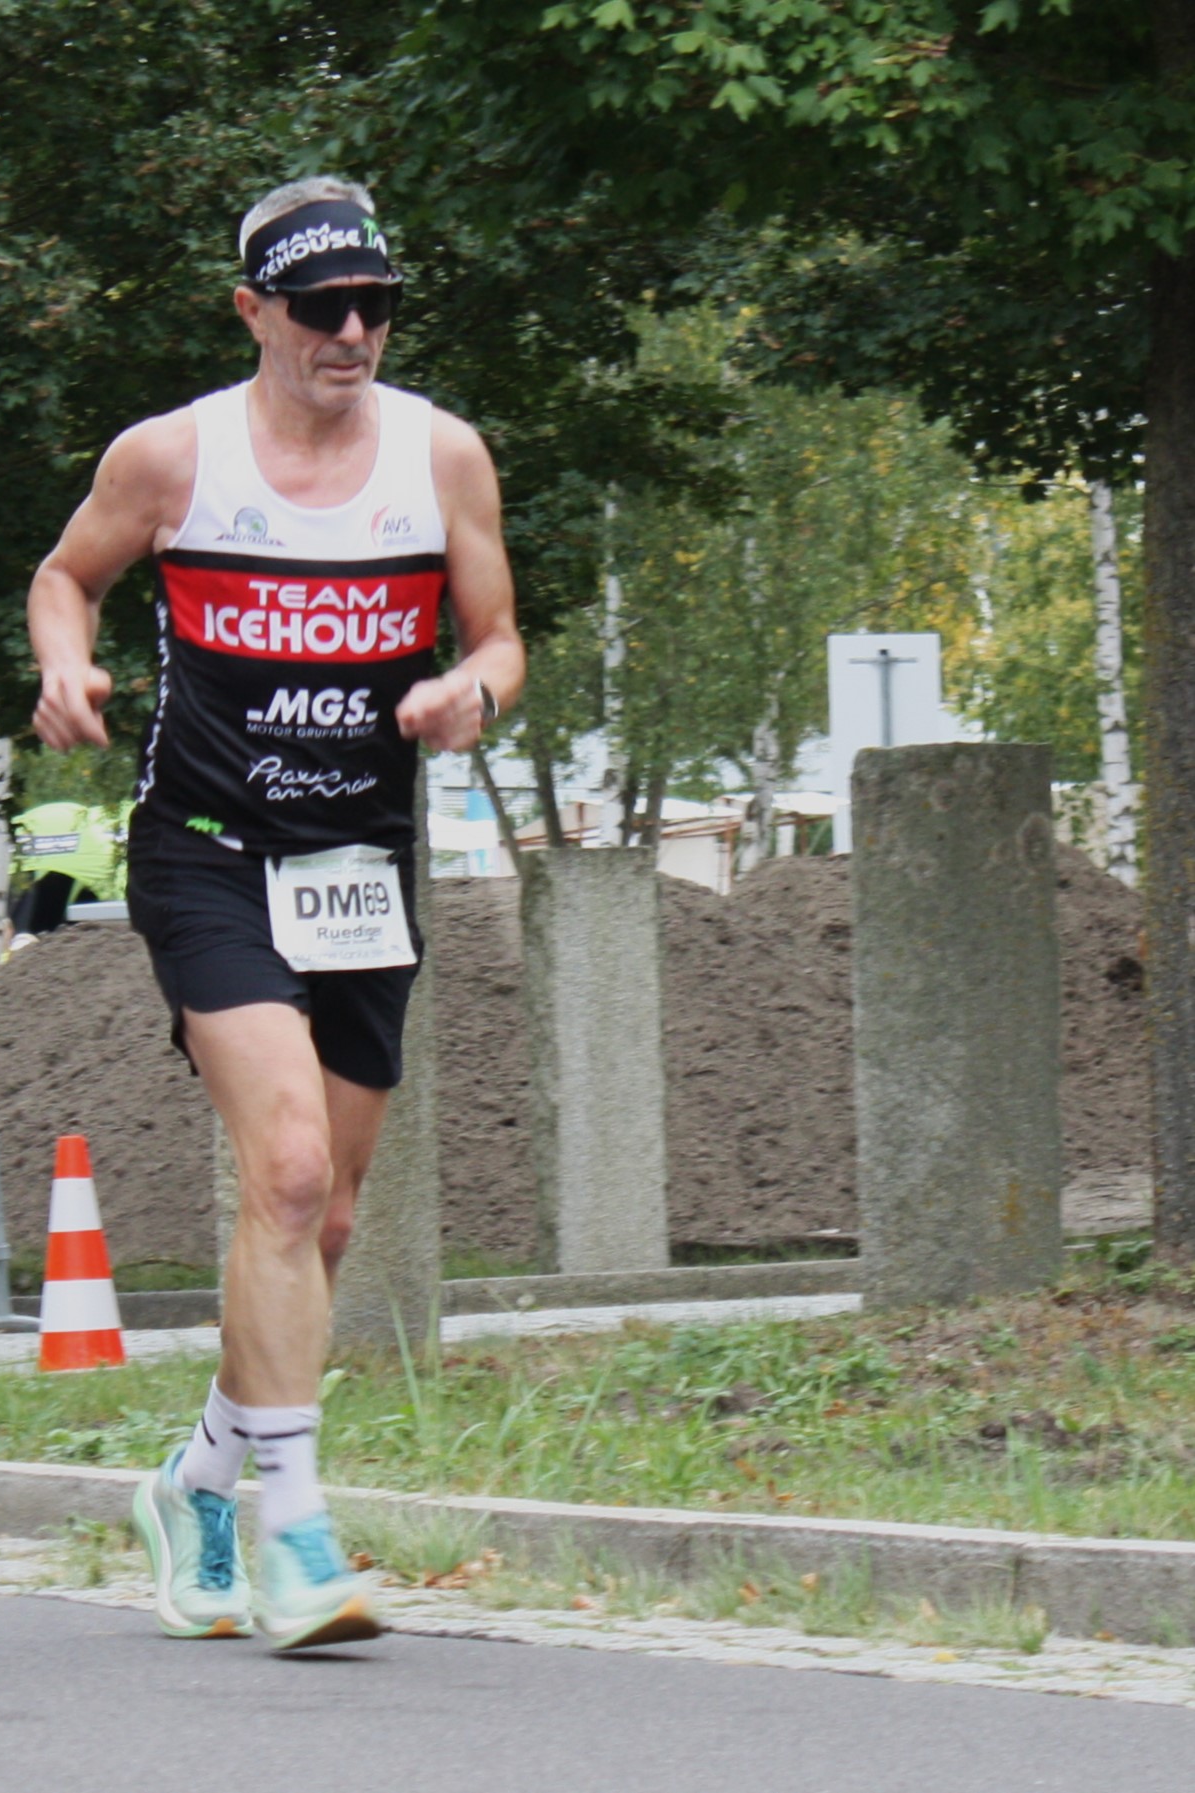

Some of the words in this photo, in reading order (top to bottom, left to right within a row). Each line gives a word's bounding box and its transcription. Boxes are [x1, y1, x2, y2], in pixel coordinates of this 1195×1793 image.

[248, 580, 389, 612] TEAM
[203, 603, 421, 655] ICEHOUSE
[246, 722, 293, 737] MOTOR
[296, 727, 344, 739] GRUPPE
